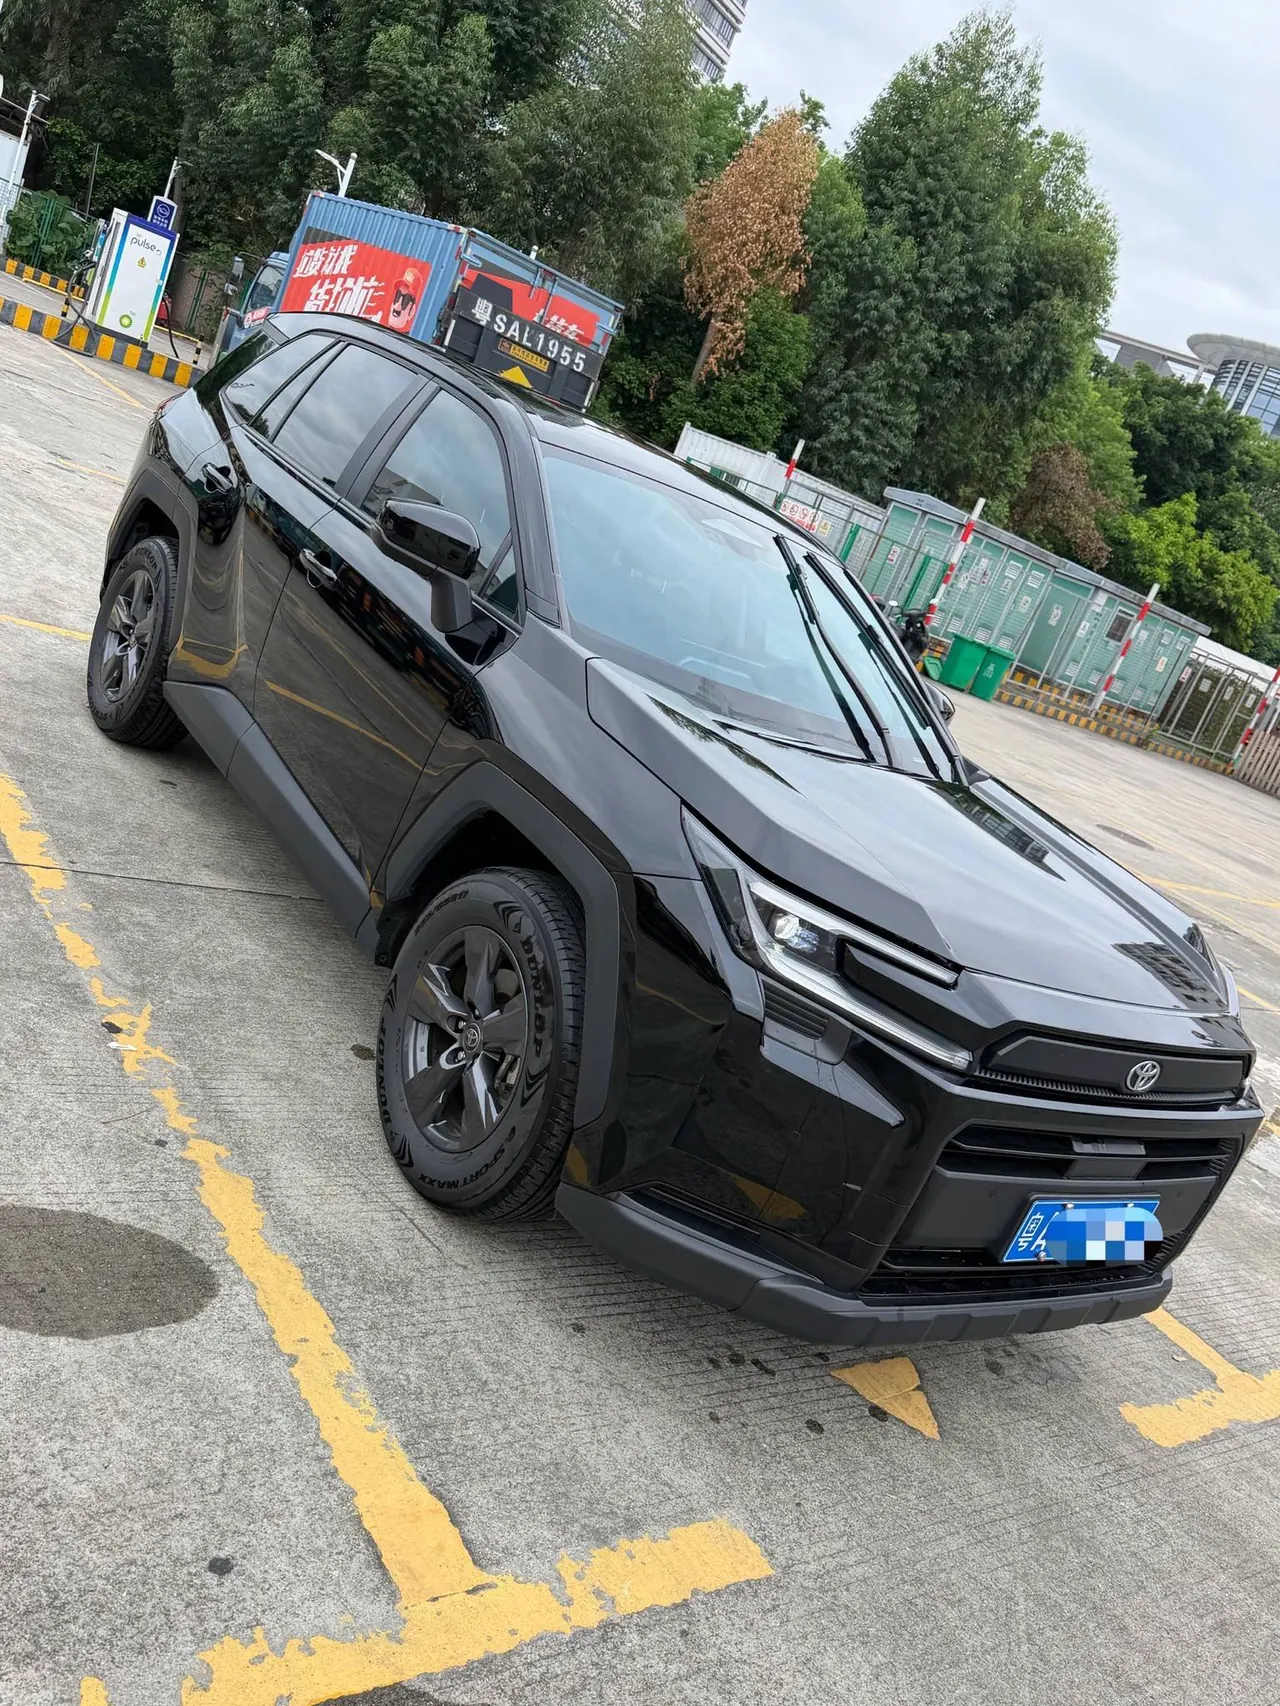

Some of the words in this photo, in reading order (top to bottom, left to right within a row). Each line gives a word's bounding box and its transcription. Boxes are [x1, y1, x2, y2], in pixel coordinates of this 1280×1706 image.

[130, 237, 157, 252] pulse
[471, 297, 587, 373] 粤SAL1955
[520, 935, 546, 1058] DUNLOP
[378, 1016, 393, 1124] DUNLOP
[418, 1173, 460, 1189] MAXX
